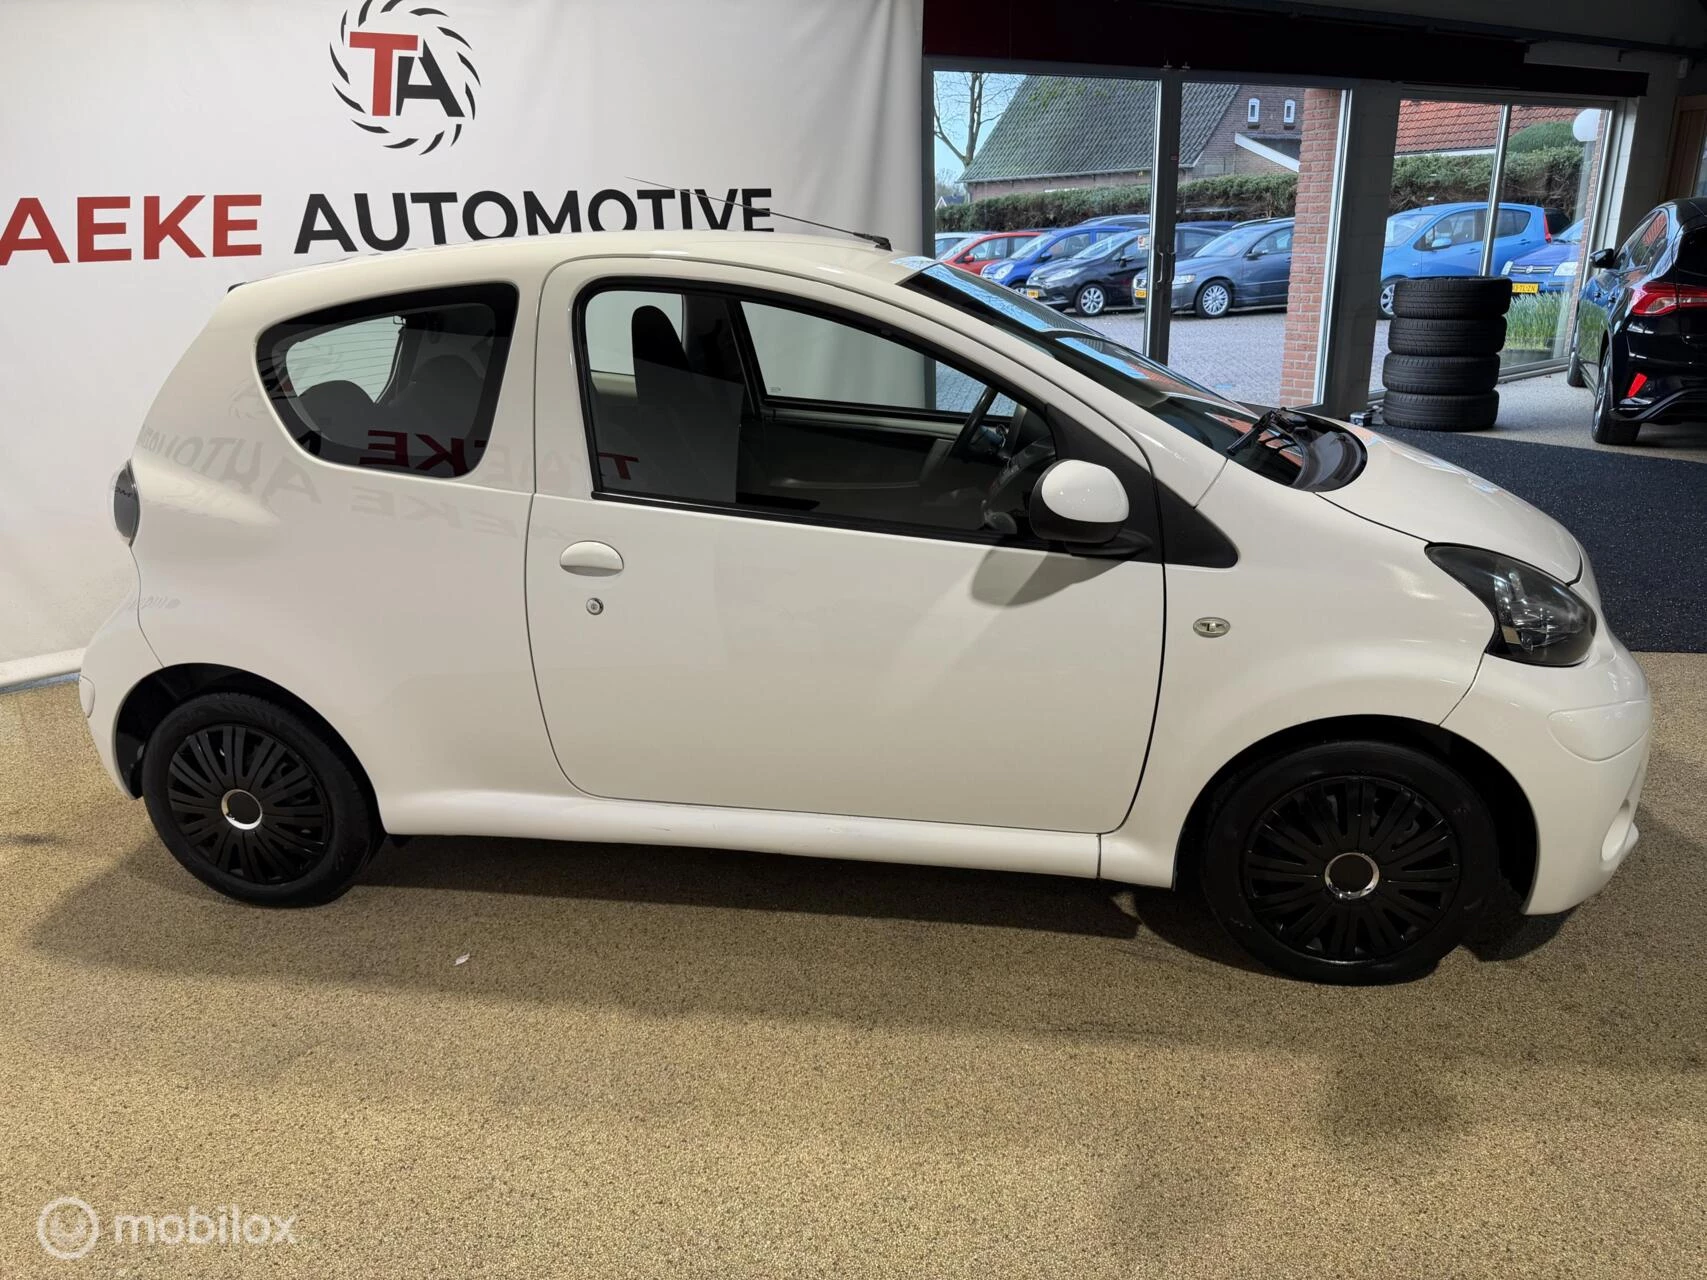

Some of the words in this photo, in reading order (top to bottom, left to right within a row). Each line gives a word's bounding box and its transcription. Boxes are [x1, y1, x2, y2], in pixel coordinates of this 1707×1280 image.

[350, 31, 466, 118] TA
[0, 193, 262, 266] AEKE
[293, 188, 775, 254] AUTOMOTIVE
